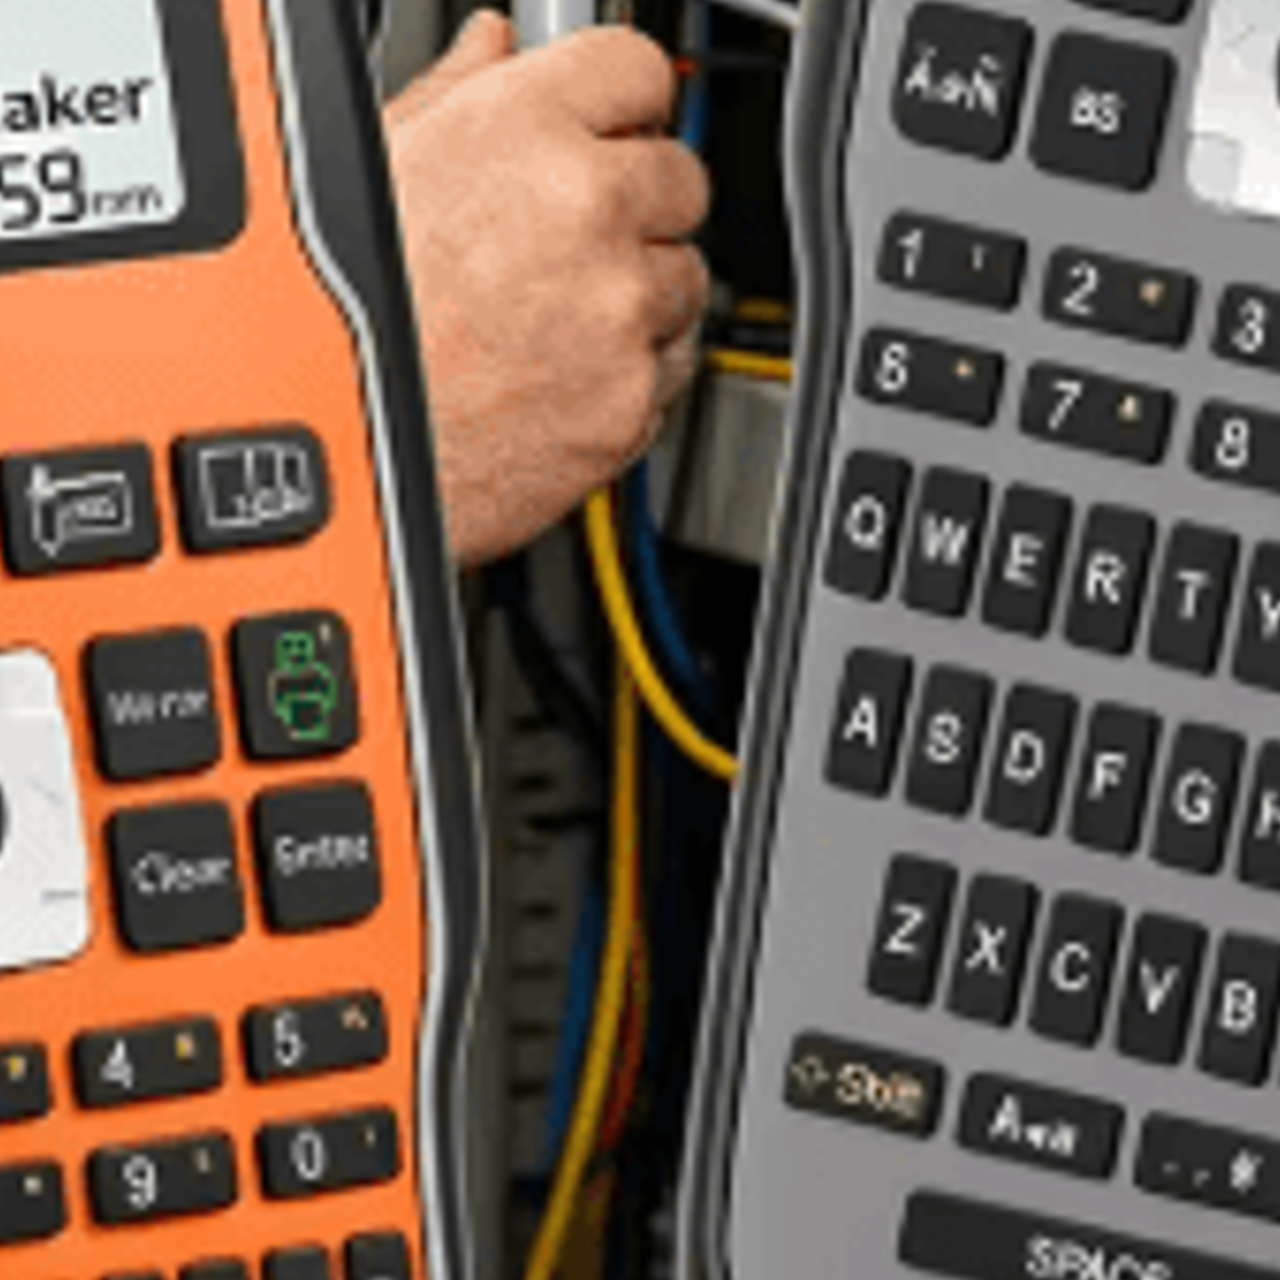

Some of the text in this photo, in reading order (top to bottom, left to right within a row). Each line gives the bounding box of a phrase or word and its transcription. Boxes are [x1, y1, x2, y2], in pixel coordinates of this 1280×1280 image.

[898, 227, 925, 280] 1
[1061, 262, 1100, 317] 2
[1231, 297, 1267, 355] 3
[1047, 378, 1084, 431] 7
[1214, 416, 1251, 470] 8
[843, 494, 887, 551] Q
[922, 515, 969, 565] W
[1002, 531, 1044, 585] E
[1084, 551, 1126, 605] R
[1176, 568, 1208, 620] T
[842, 695, 879, 748] A
[924, 711, 963, 765] S
[1002, 728, 1046, 784] D
[1090, 750, 1127, 797] F
[1173, 769, 1216, 825] G
[884, 902, 926, 955] Z
[964, 924, 1008, 973] X
[1048, 940, 1092, 993] C
[1139, 962, 1177, 1015] V
[1219, 978, 1258, 1033] B
[101, 1038, 134, 1090] 4
[272, 1009, 304, 1069] 5
[121, 1154, 158, 1209] 9
[291, 1129, 326, 1182] 0
